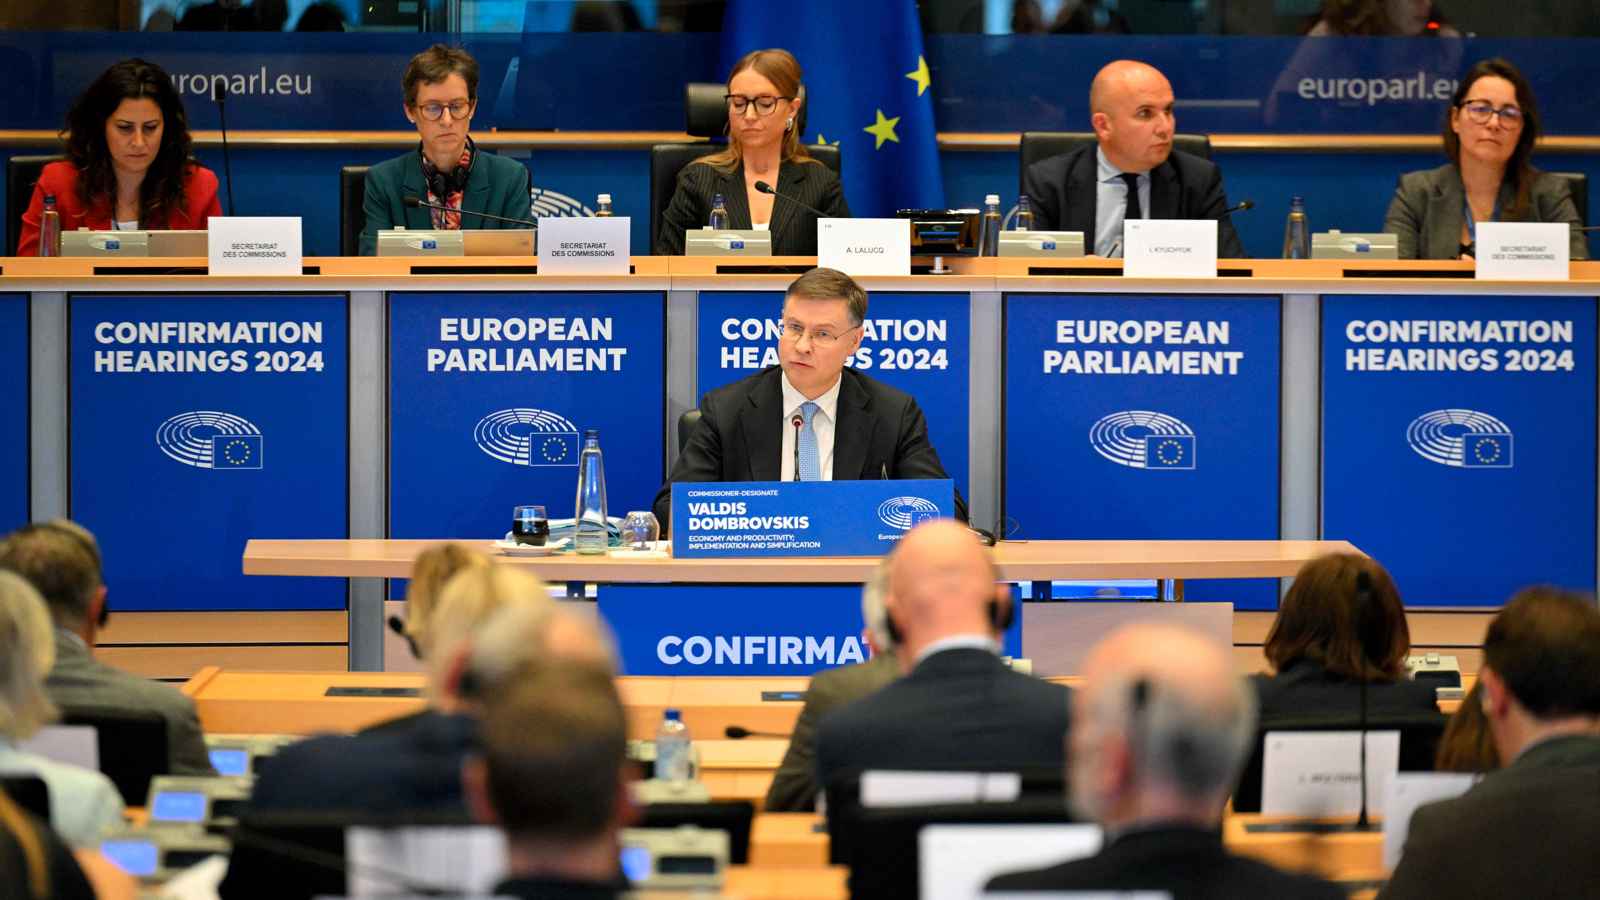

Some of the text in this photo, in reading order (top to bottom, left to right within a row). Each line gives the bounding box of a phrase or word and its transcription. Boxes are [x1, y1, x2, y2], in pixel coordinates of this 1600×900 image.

[172, 66, 312, 101] roparl.eu
[231, 242, 278, 250] SECRETARIAT
[94, 321, 323, 344] CONFIRMATION
[440, 317, 613, 342] EUROPEAN
[720, 318, 947, 342] CONATION
[1056, 319, 1230, 345] EUROPEAN
[1345, 319, 1573, 343] CONFIRMATION
[94, 350, 325, 373] HEARINGS 2024
[427, 347, 627, 372] PARLIAMENT
[720, 346, 949, 371] HEAS 2024
[1043, 349, 1244, 376] PARLIAMENT
[1345, 348, 1575, 372] HEARINGS 2024
[687, 489, 779, 497] COMMISSIONER-DESIGNATE
[688, 502, 747, 516] VALDIS
[688, 516, 810, 531] DOMBROVSKIS
[688, 535, 725, 543] ECONOMY
[726, 534, 741, 542] AND
[688, 541, 821, 550] IMPLEMENTATION AND SIMPLIFICATION
[656, 635, 874, 665] CONFIRMA
